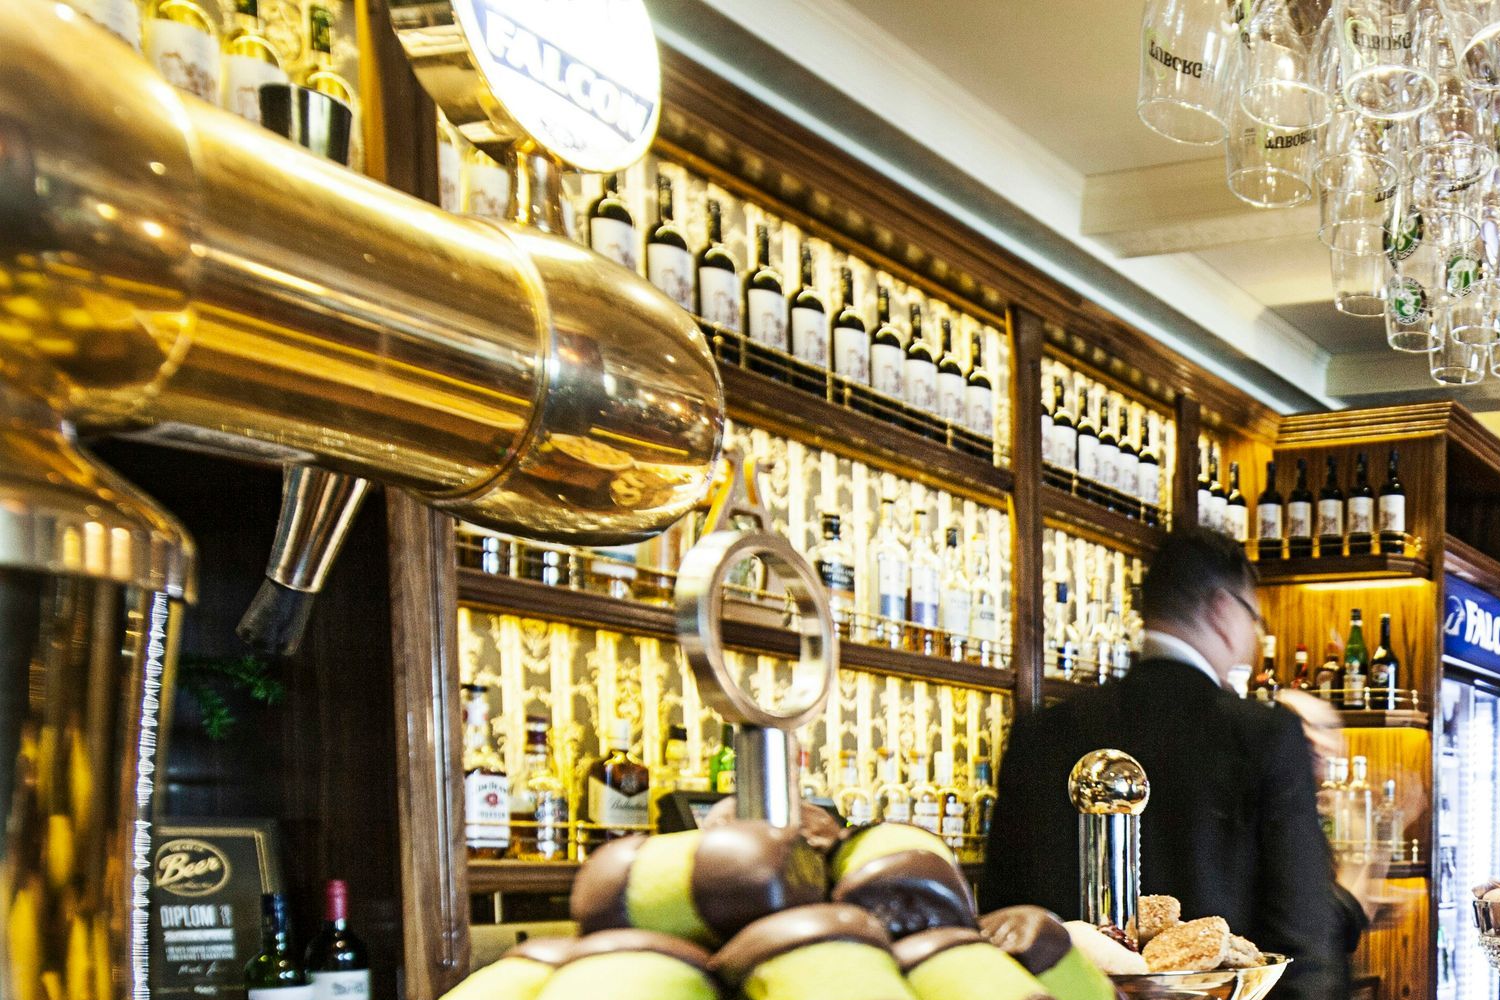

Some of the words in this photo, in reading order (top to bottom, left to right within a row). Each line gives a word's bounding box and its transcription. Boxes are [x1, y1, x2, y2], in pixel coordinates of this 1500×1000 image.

[485, 9, 651, 139] FALCON
[156, 853, 220, 886] Beer
[160, 905, 216, 928] DIPLOM
